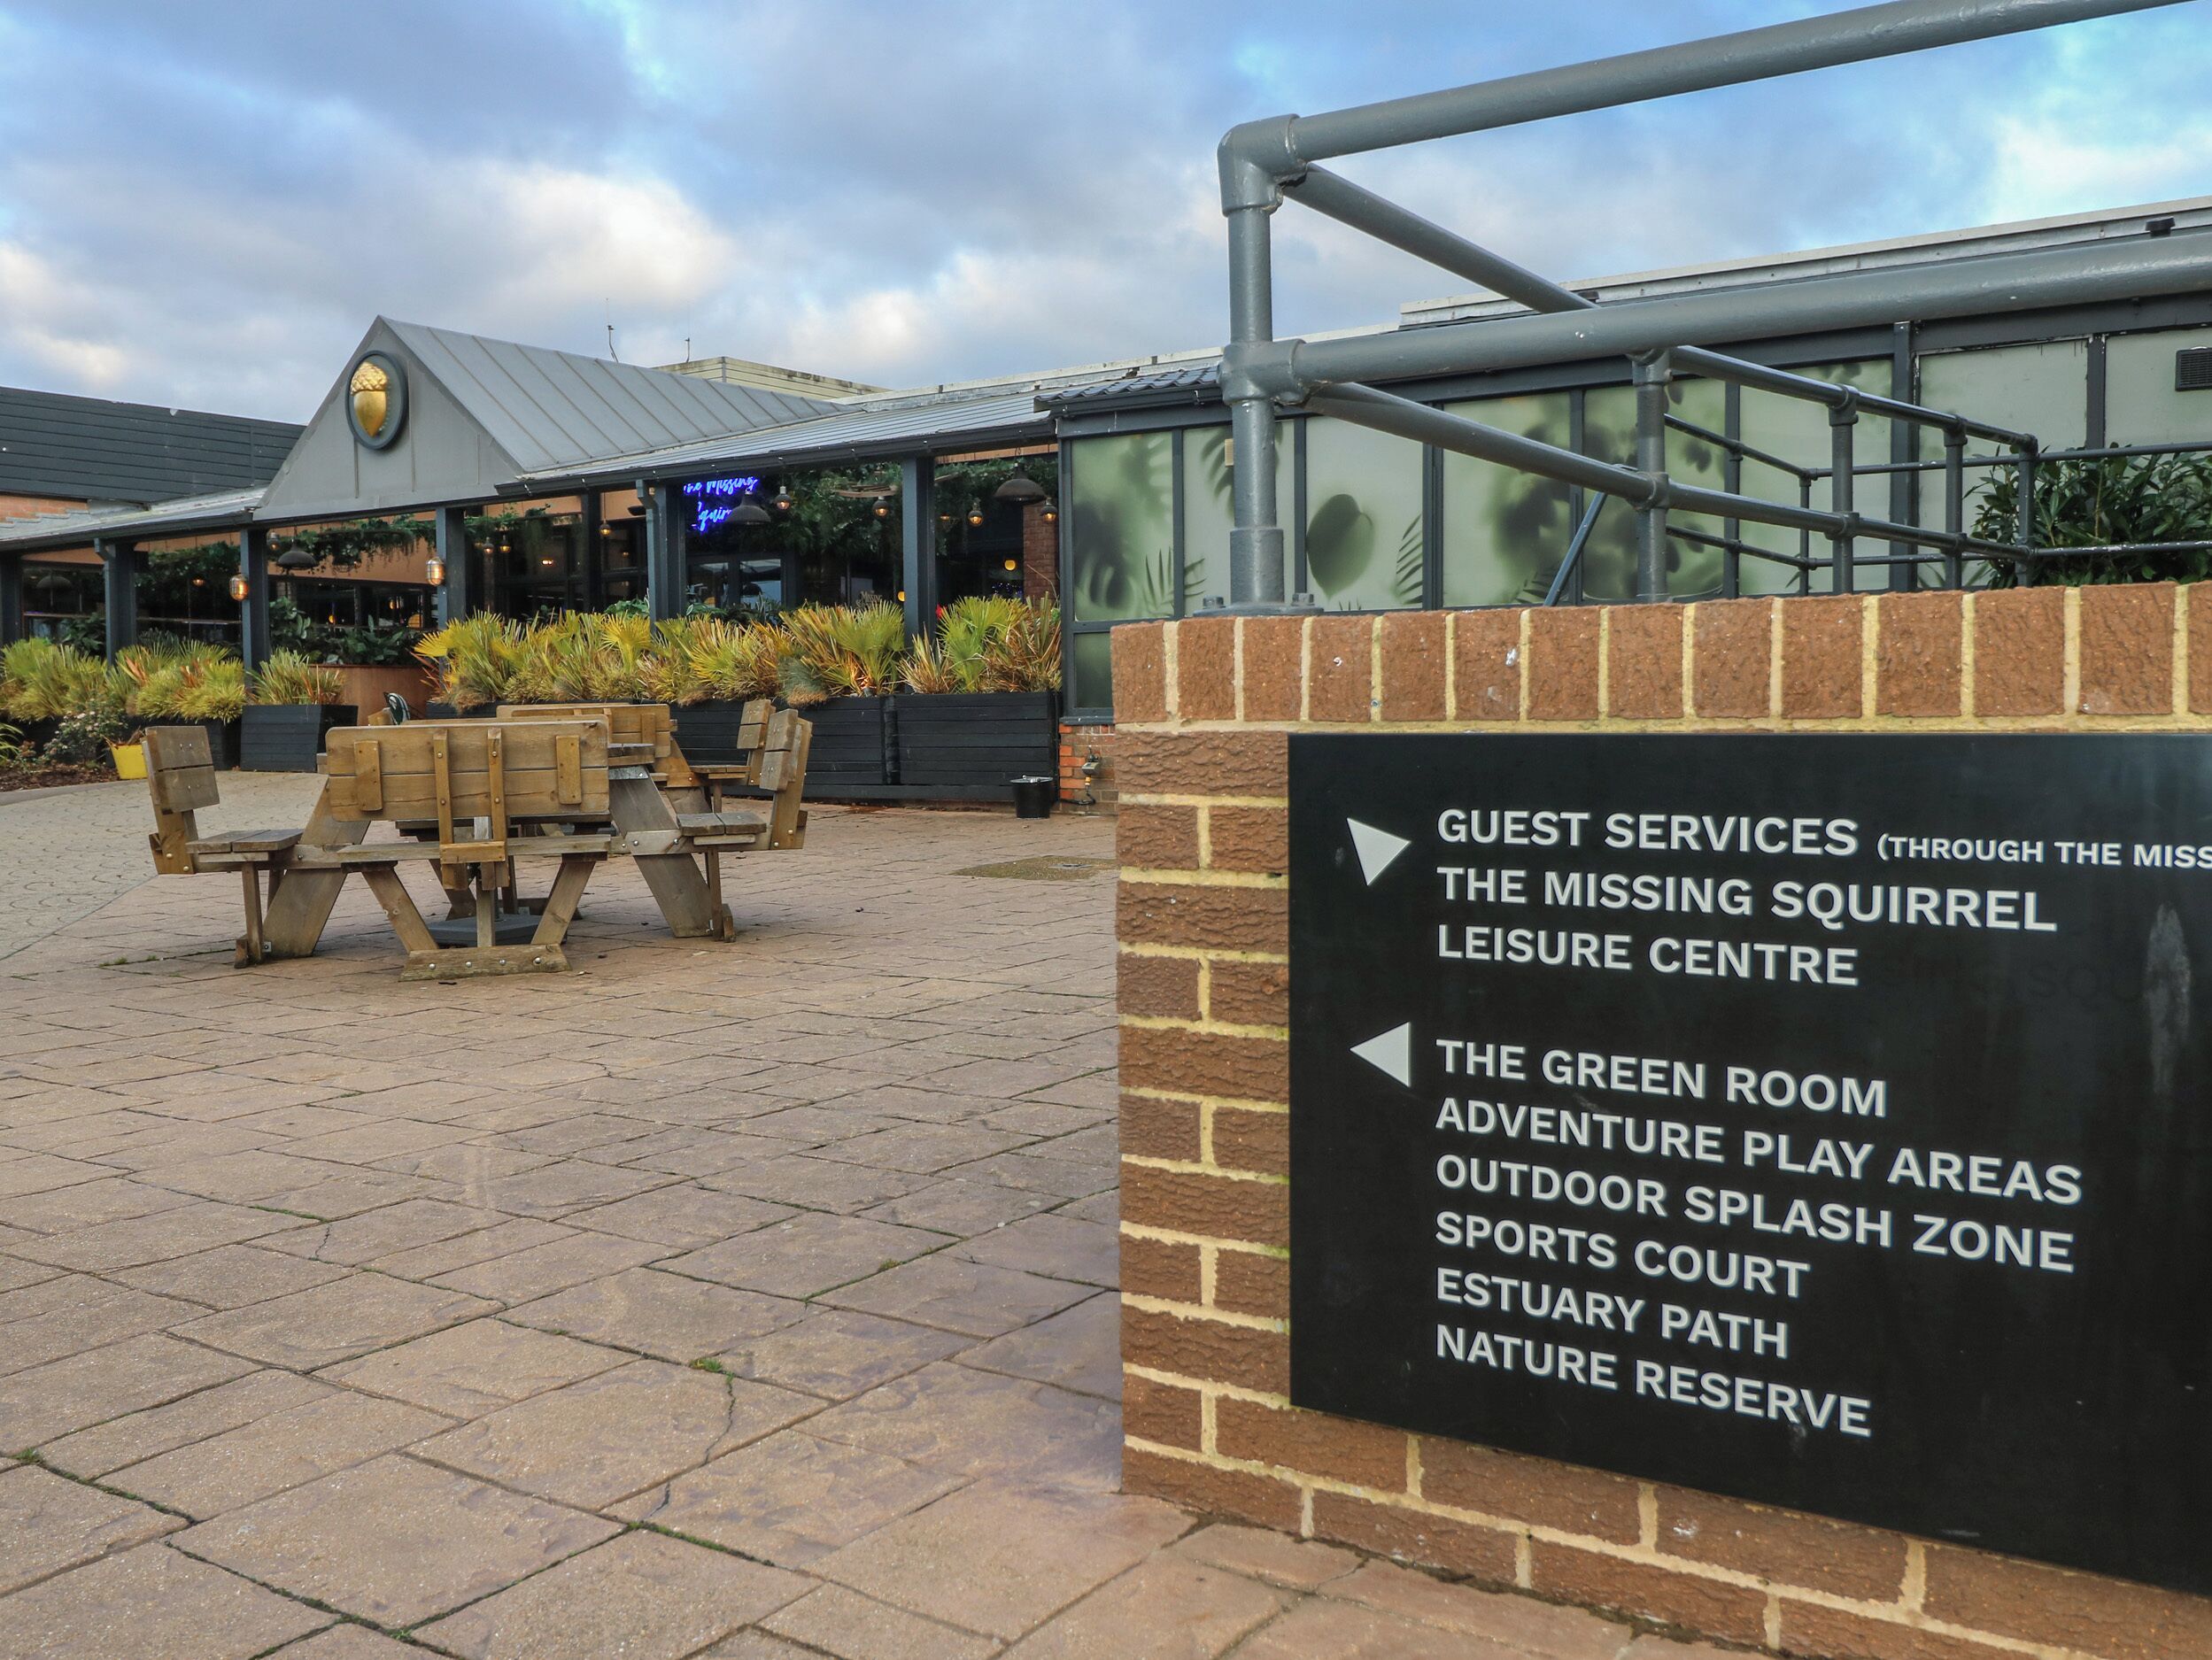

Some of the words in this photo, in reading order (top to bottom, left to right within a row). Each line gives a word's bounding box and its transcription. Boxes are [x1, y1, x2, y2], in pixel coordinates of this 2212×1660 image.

[1437, 808, 1591, 846] GUEST
[1605, 813, 1859, 856] SERVICES
[1877, 833, 2044, 863] (THROUGH
[2053, 841, 2123, 866] THE
[1436, 866, 1528, 904] THE
[1544, 870, 1752, 915] MISSING
[1770, 880, 2058, 932] SQUIRREL
[1438, 923, 1632, 970] LEISURE
[1649, 937, 1859, 986] CENTRE
[1435, 1038, 1527, 1081] THE
[1542, 1049, 1705, 1099] GREEN
[1726, 1066, 1886, 1118] ROOM
[1435, 1097, 1725, 1163] ADVENTURE
[1744, 1130, 1875, 1180] PLAY
[1887, 1147, 2082, 1205] AREAS
[1435, 1211, 1617, 1269] SPORTS
[1634, 1239, 1811, 1298] COURT
[1436, 1154, 1667, 1217] OUTDOOR
[1683, 1185, 1891, 1248] SPLASH
[1912, 1214, 2074, 1273] ZONE
[1437, 1267, 1645, 1332] ESTUARY
[1661, 1303, 1788, 1359] PATH
[1436, 1324, 1618, 1390] NATURE
[1636, 1359, 1871, 1437] RESERVE
